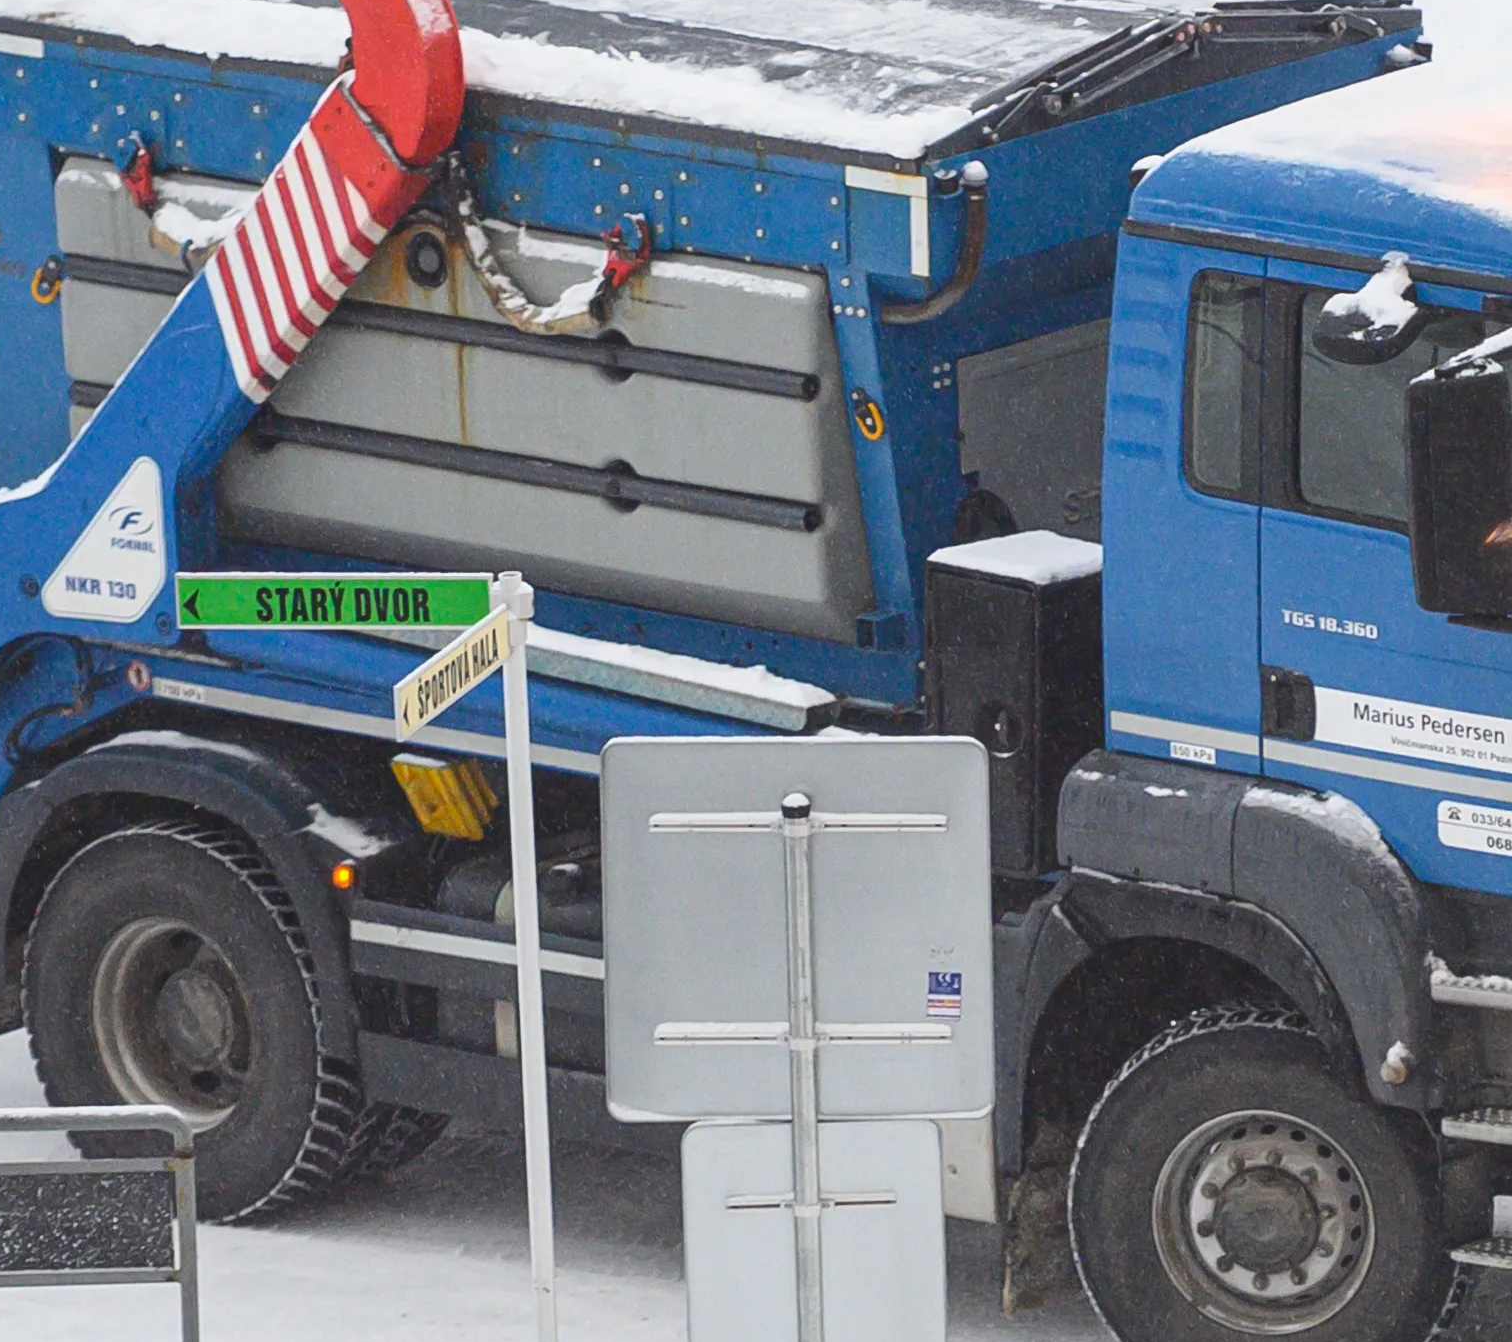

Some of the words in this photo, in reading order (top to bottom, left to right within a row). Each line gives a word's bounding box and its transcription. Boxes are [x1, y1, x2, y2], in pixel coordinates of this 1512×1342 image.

[65, 575, 101, 596] NKR
[107, 580, 136, 600] 130
[255, 581, 345, 623] STARÝ
[354, 587, 430, 623] DVOR
[1281, 608, 1315, 628] TGS
[1318, 616, 1378, 639] 18.360
[417, 643, 471, 720] ŠPORTOVÁ
[472, 628, 499, 678] HALA
[1353, 702, 1415, 729] Marius
[1421, 714, 1505, 744] Pedersen
